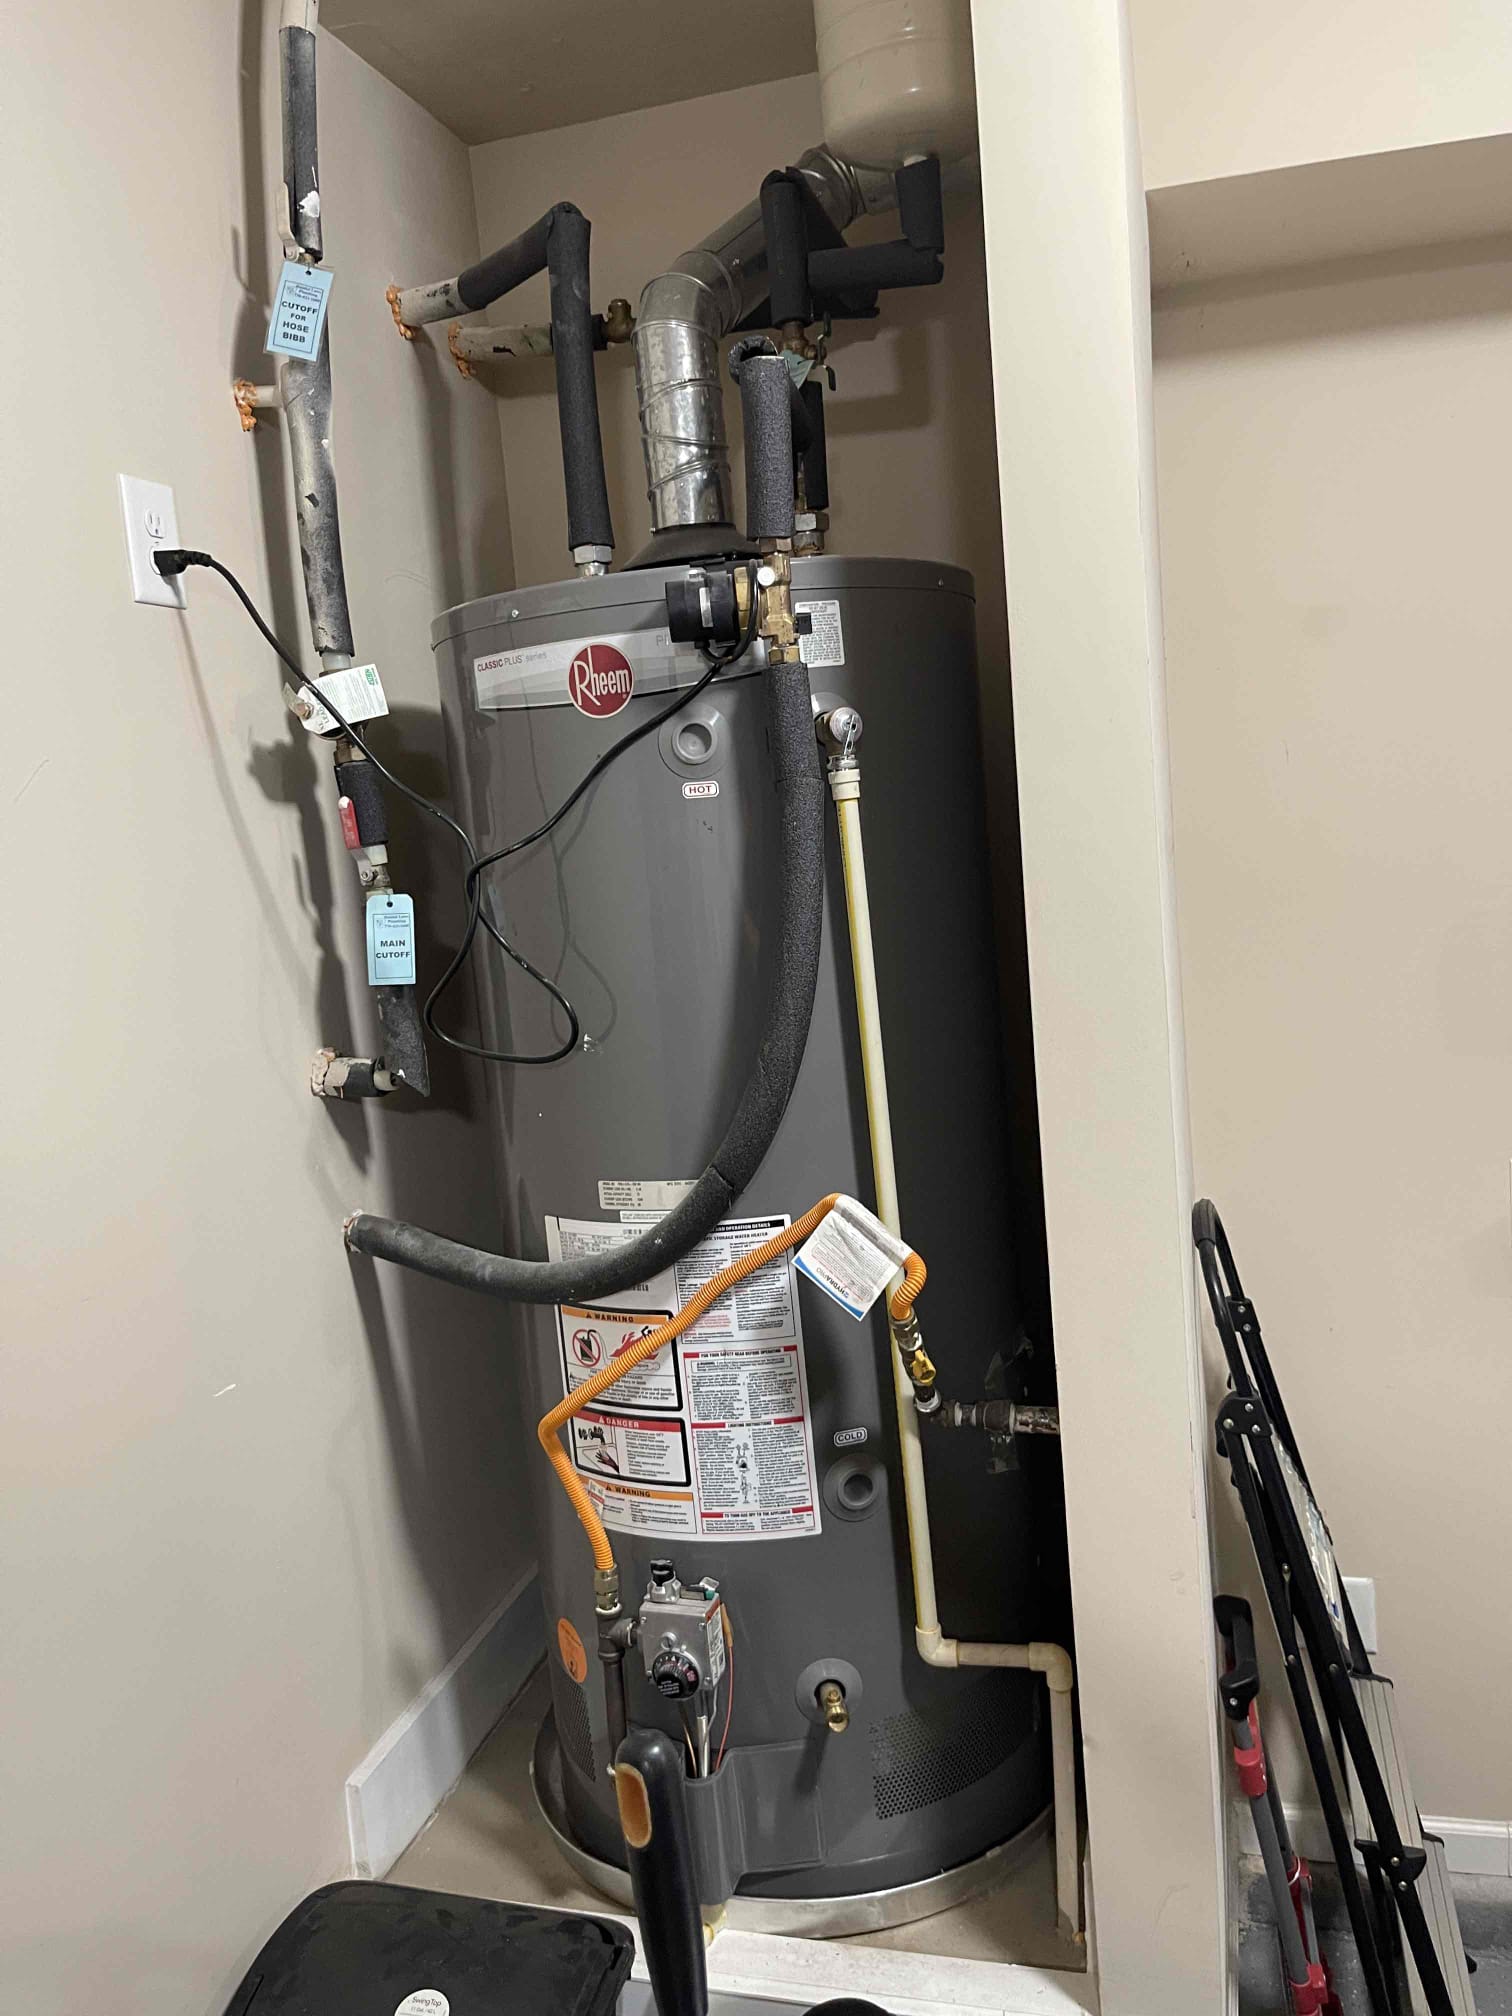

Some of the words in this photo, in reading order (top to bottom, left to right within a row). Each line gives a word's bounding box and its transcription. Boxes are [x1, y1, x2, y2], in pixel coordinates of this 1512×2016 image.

[281, 301, 318, 315] CUTOFF
[290, 312, 306, 322] FOR
[282, 321, 310, 333] HOSE
[282, 331, 306, 343] BIBB
[477, 658, 504, 672] CLASSIC
[504, 655, 523, 666] PLUS
[573, 646, 631, 706] Rheem
[689, 785, 712, 794] HOT
[380, 939, 406, 948] MAIN
[375, 951, 411, 959] CUTOFF
[594, 1313, 634, 1323] WARNING
[606, 1417, 640, 1428] DANGER
[837, 1431, 863, 1441] COLD
[615, 1485, 651, 1498] WARNING
